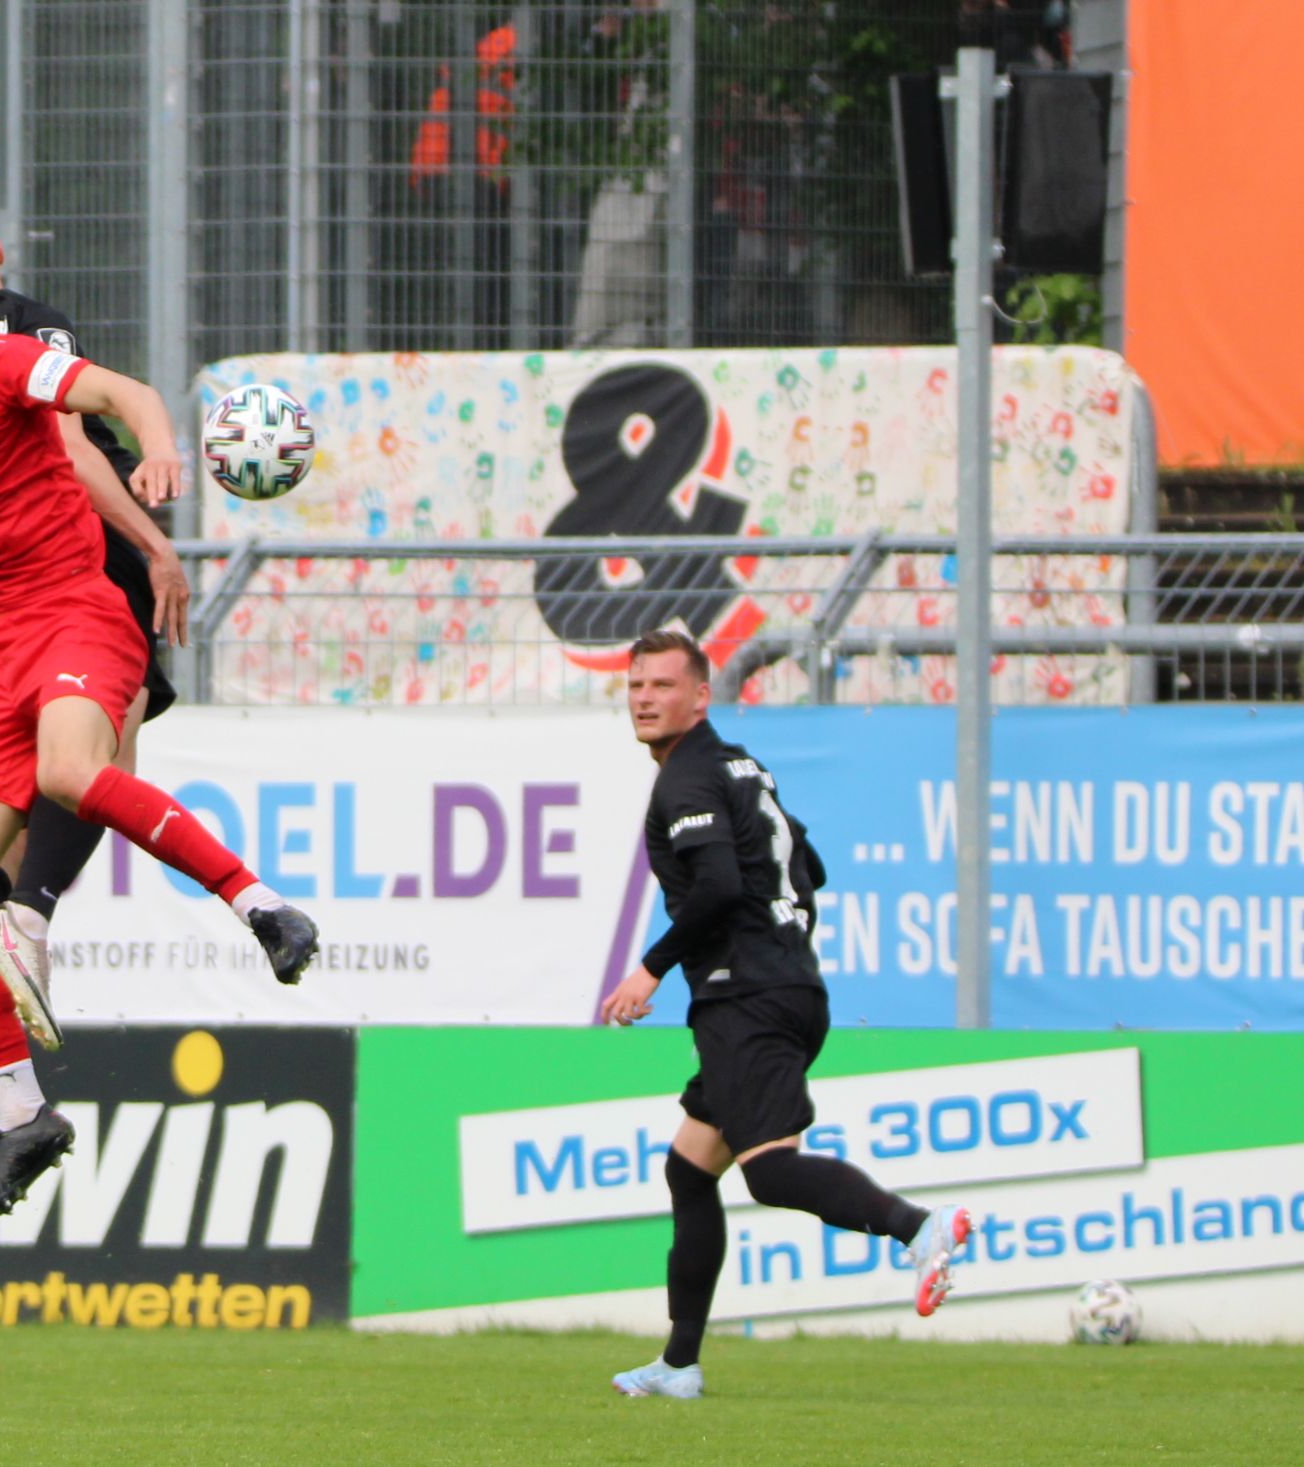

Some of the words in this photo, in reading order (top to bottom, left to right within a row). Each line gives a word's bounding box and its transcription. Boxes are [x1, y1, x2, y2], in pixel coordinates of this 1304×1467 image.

[1114, 780, 1190, 866] DU
[168, 933, 219, 969] FÜR
[868, 1089, 1089, 1160] 300x
[738, 1229, 803, 1286] in
